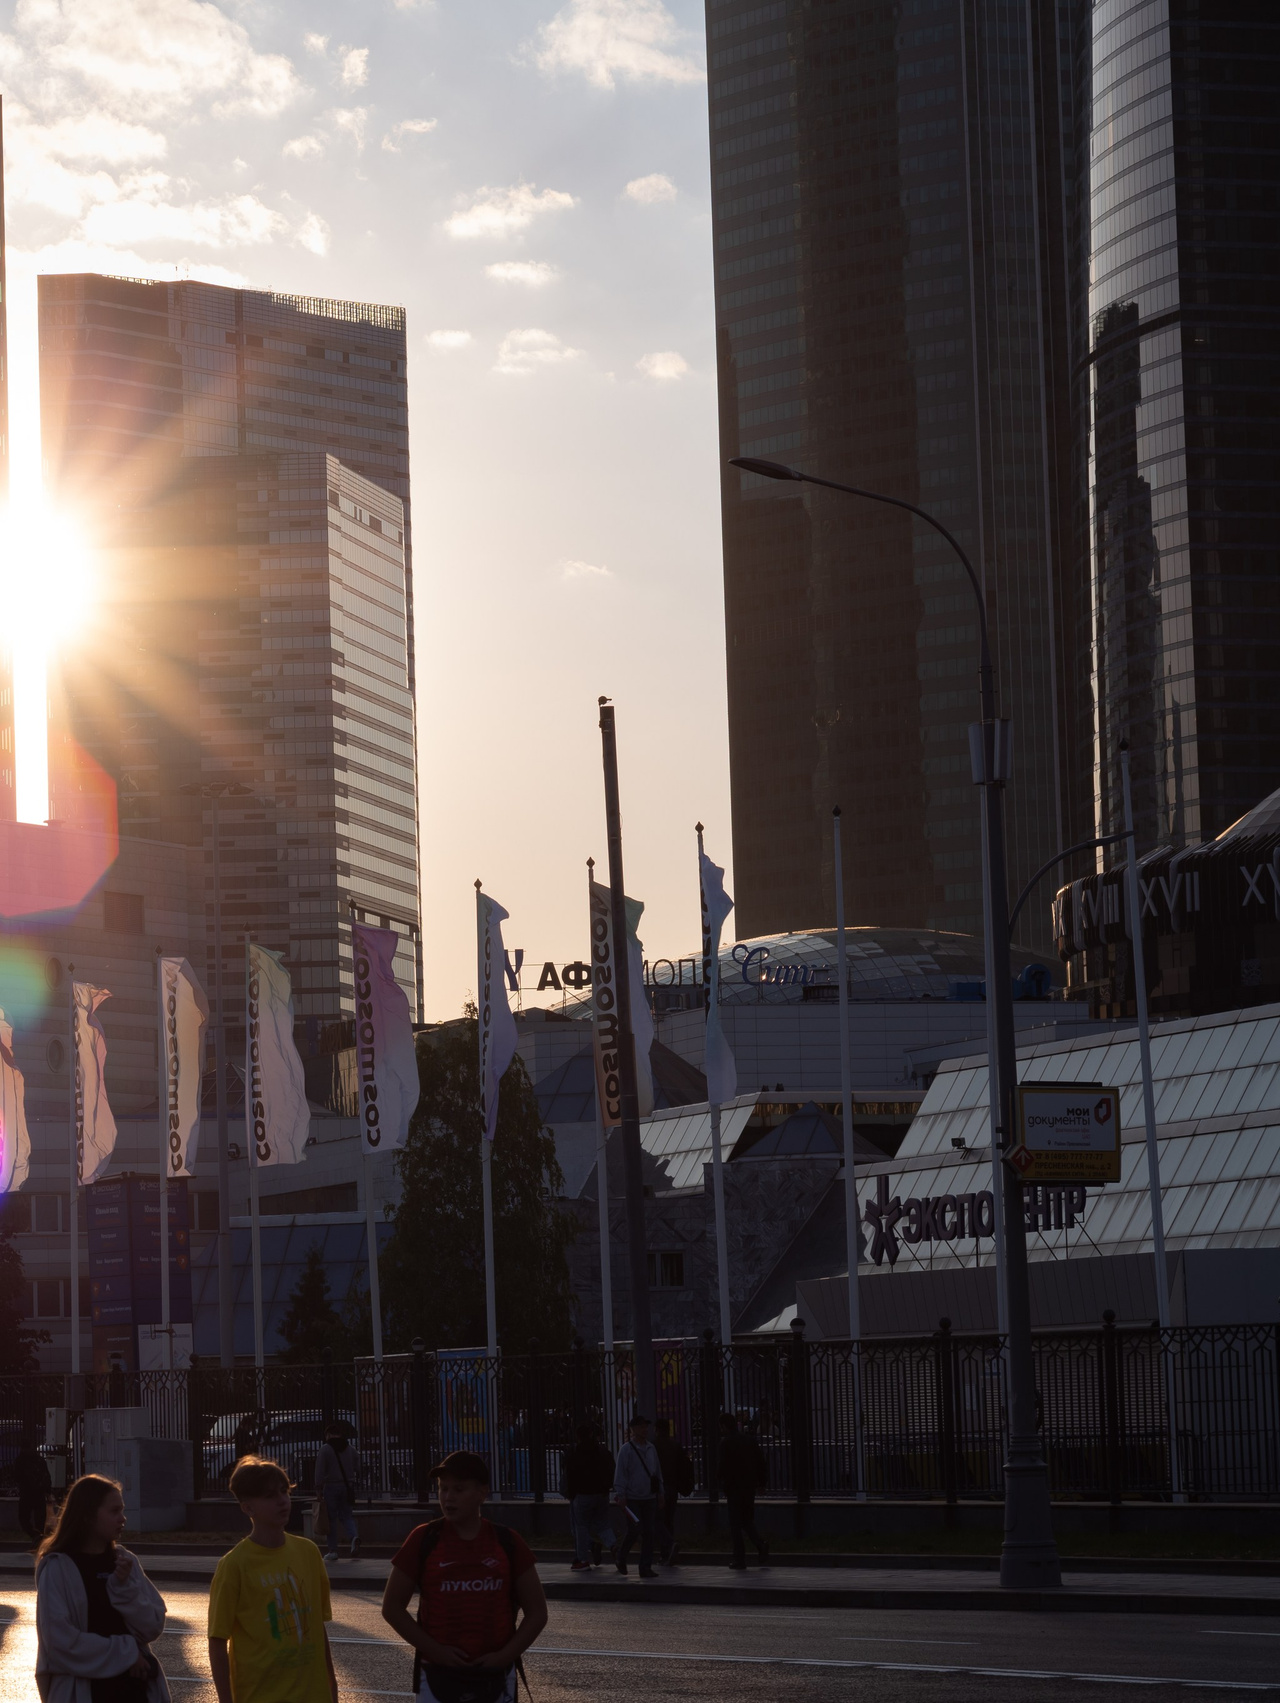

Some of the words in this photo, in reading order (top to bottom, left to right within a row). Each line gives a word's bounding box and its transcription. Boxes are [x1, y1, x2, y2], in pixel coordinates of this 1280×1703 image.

[1138, 871, 1200, 918] XVII
[1027, 1116, 1090, 1127] документы
[902, 1187, 1087, 1243] ЭКСПОНТР
[440, 1576, 504, 1592] ЛУКОЙЛ
